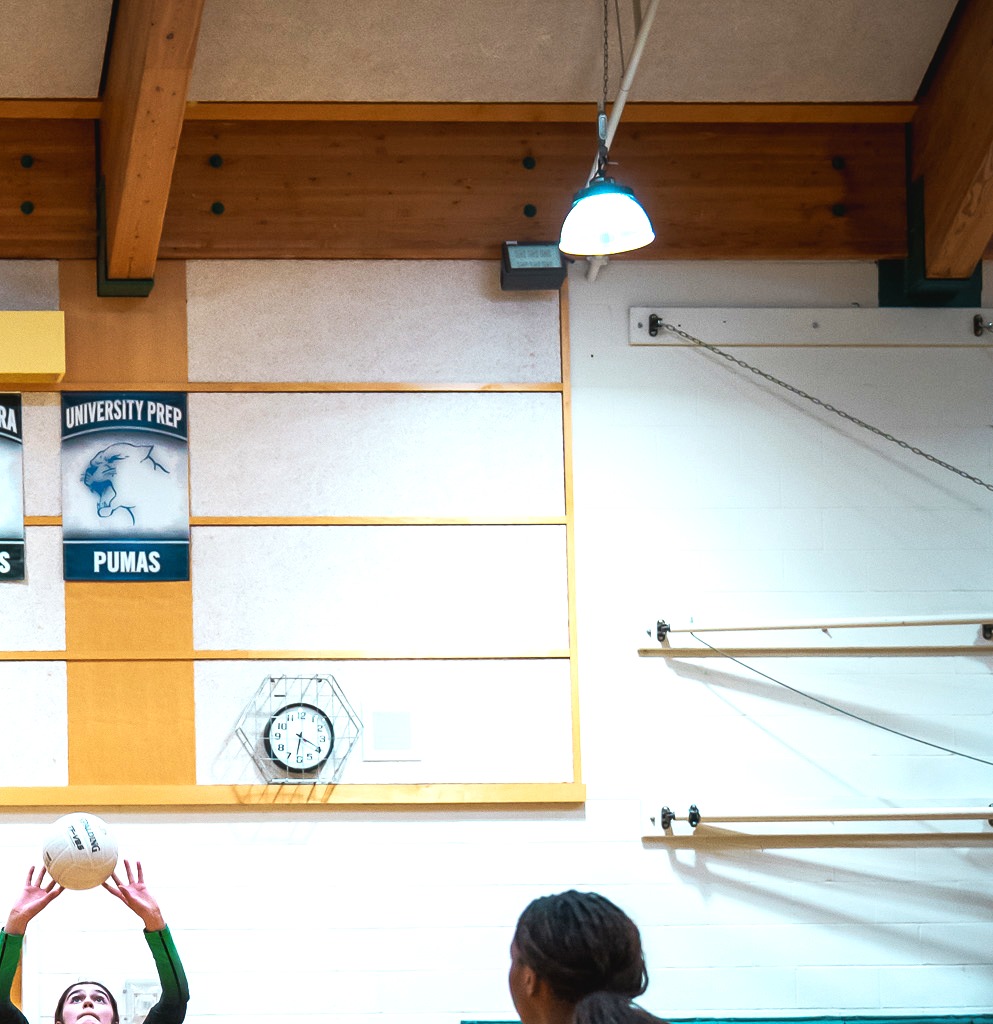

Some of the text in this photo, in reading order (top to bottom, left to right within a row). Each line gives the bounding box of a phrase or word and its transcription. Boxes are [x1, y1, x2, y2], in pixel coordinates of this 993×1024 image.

[66, 399, 182, 429] UNIVERSITY PREP
[93, 551, 161, 573] PUMAS
